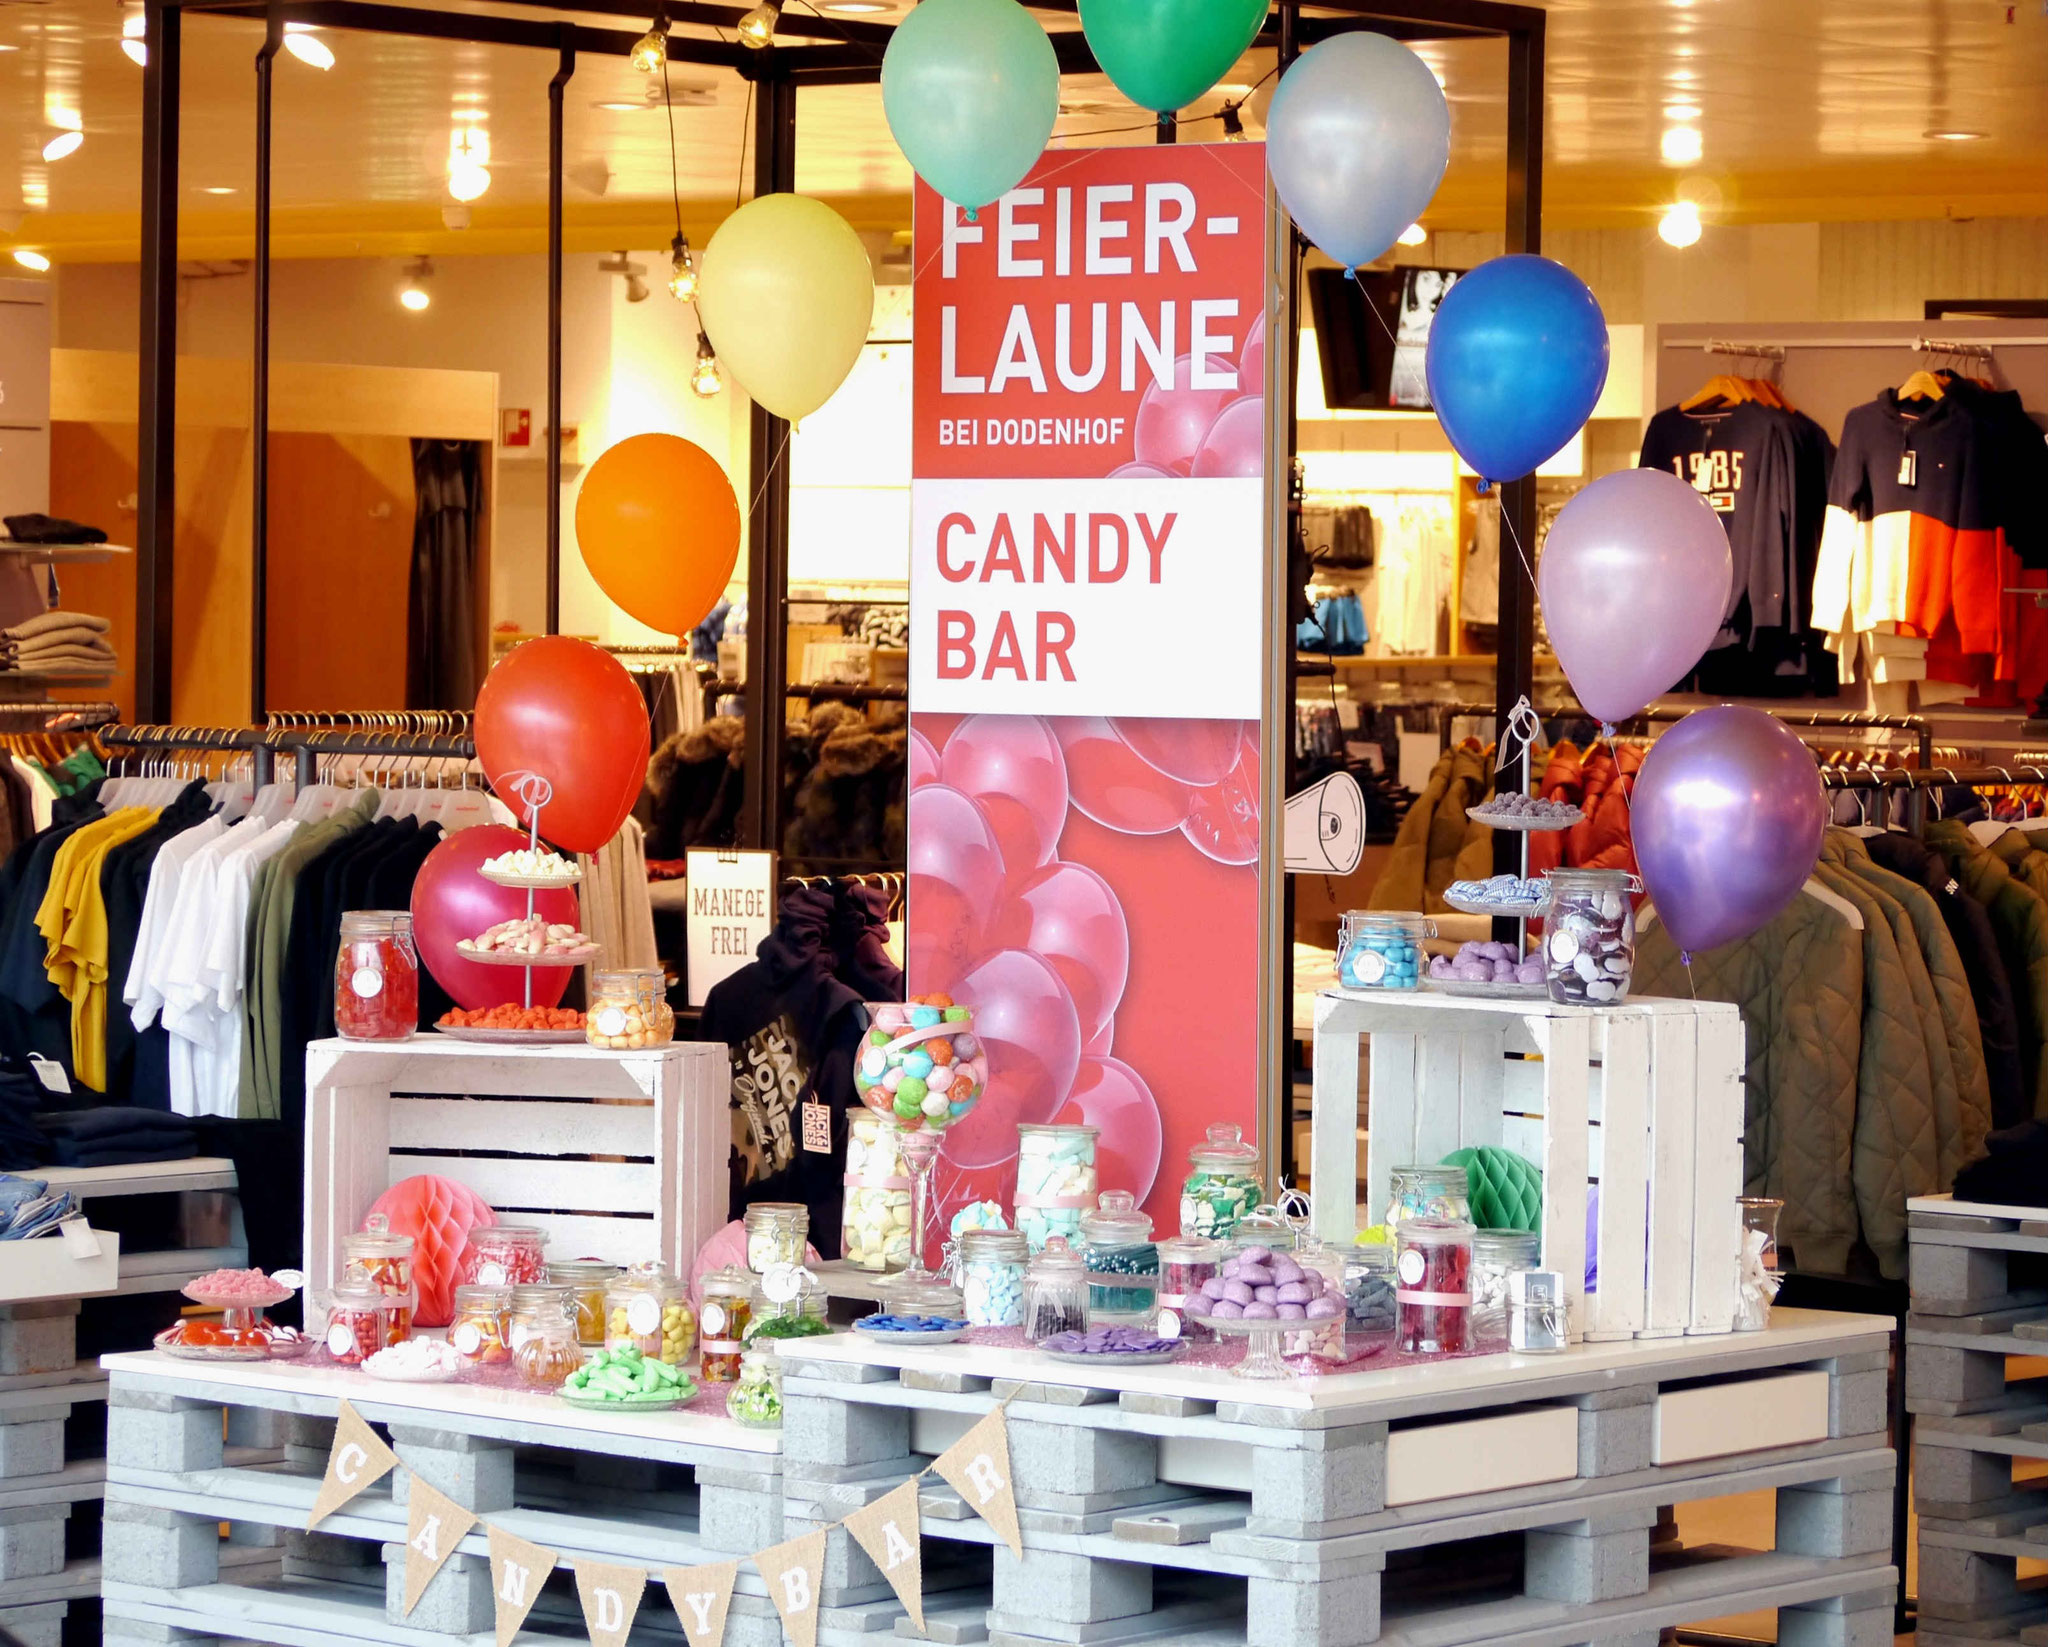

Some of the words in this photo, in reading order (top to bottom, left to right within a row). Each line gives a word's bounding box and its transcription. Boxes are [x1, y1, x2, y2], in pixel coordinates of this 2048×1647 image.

[942, 181, 1239, 279] FEIER-
[940, 299, 1239, 394] LAUNE
[939, 418, 978, 446] BEI
[986, 417, 1125, 446] DODENHOF
[935, 512, 1178, 584] CANDY
[936, 609, 1077, 682] BAR
[693, 888, 765, 917] MANEGE
[711, 926, 748, 955] FREI
[747, 1047, 792, 1160] JONES
[768, 1034, 801, 1113] JAC
